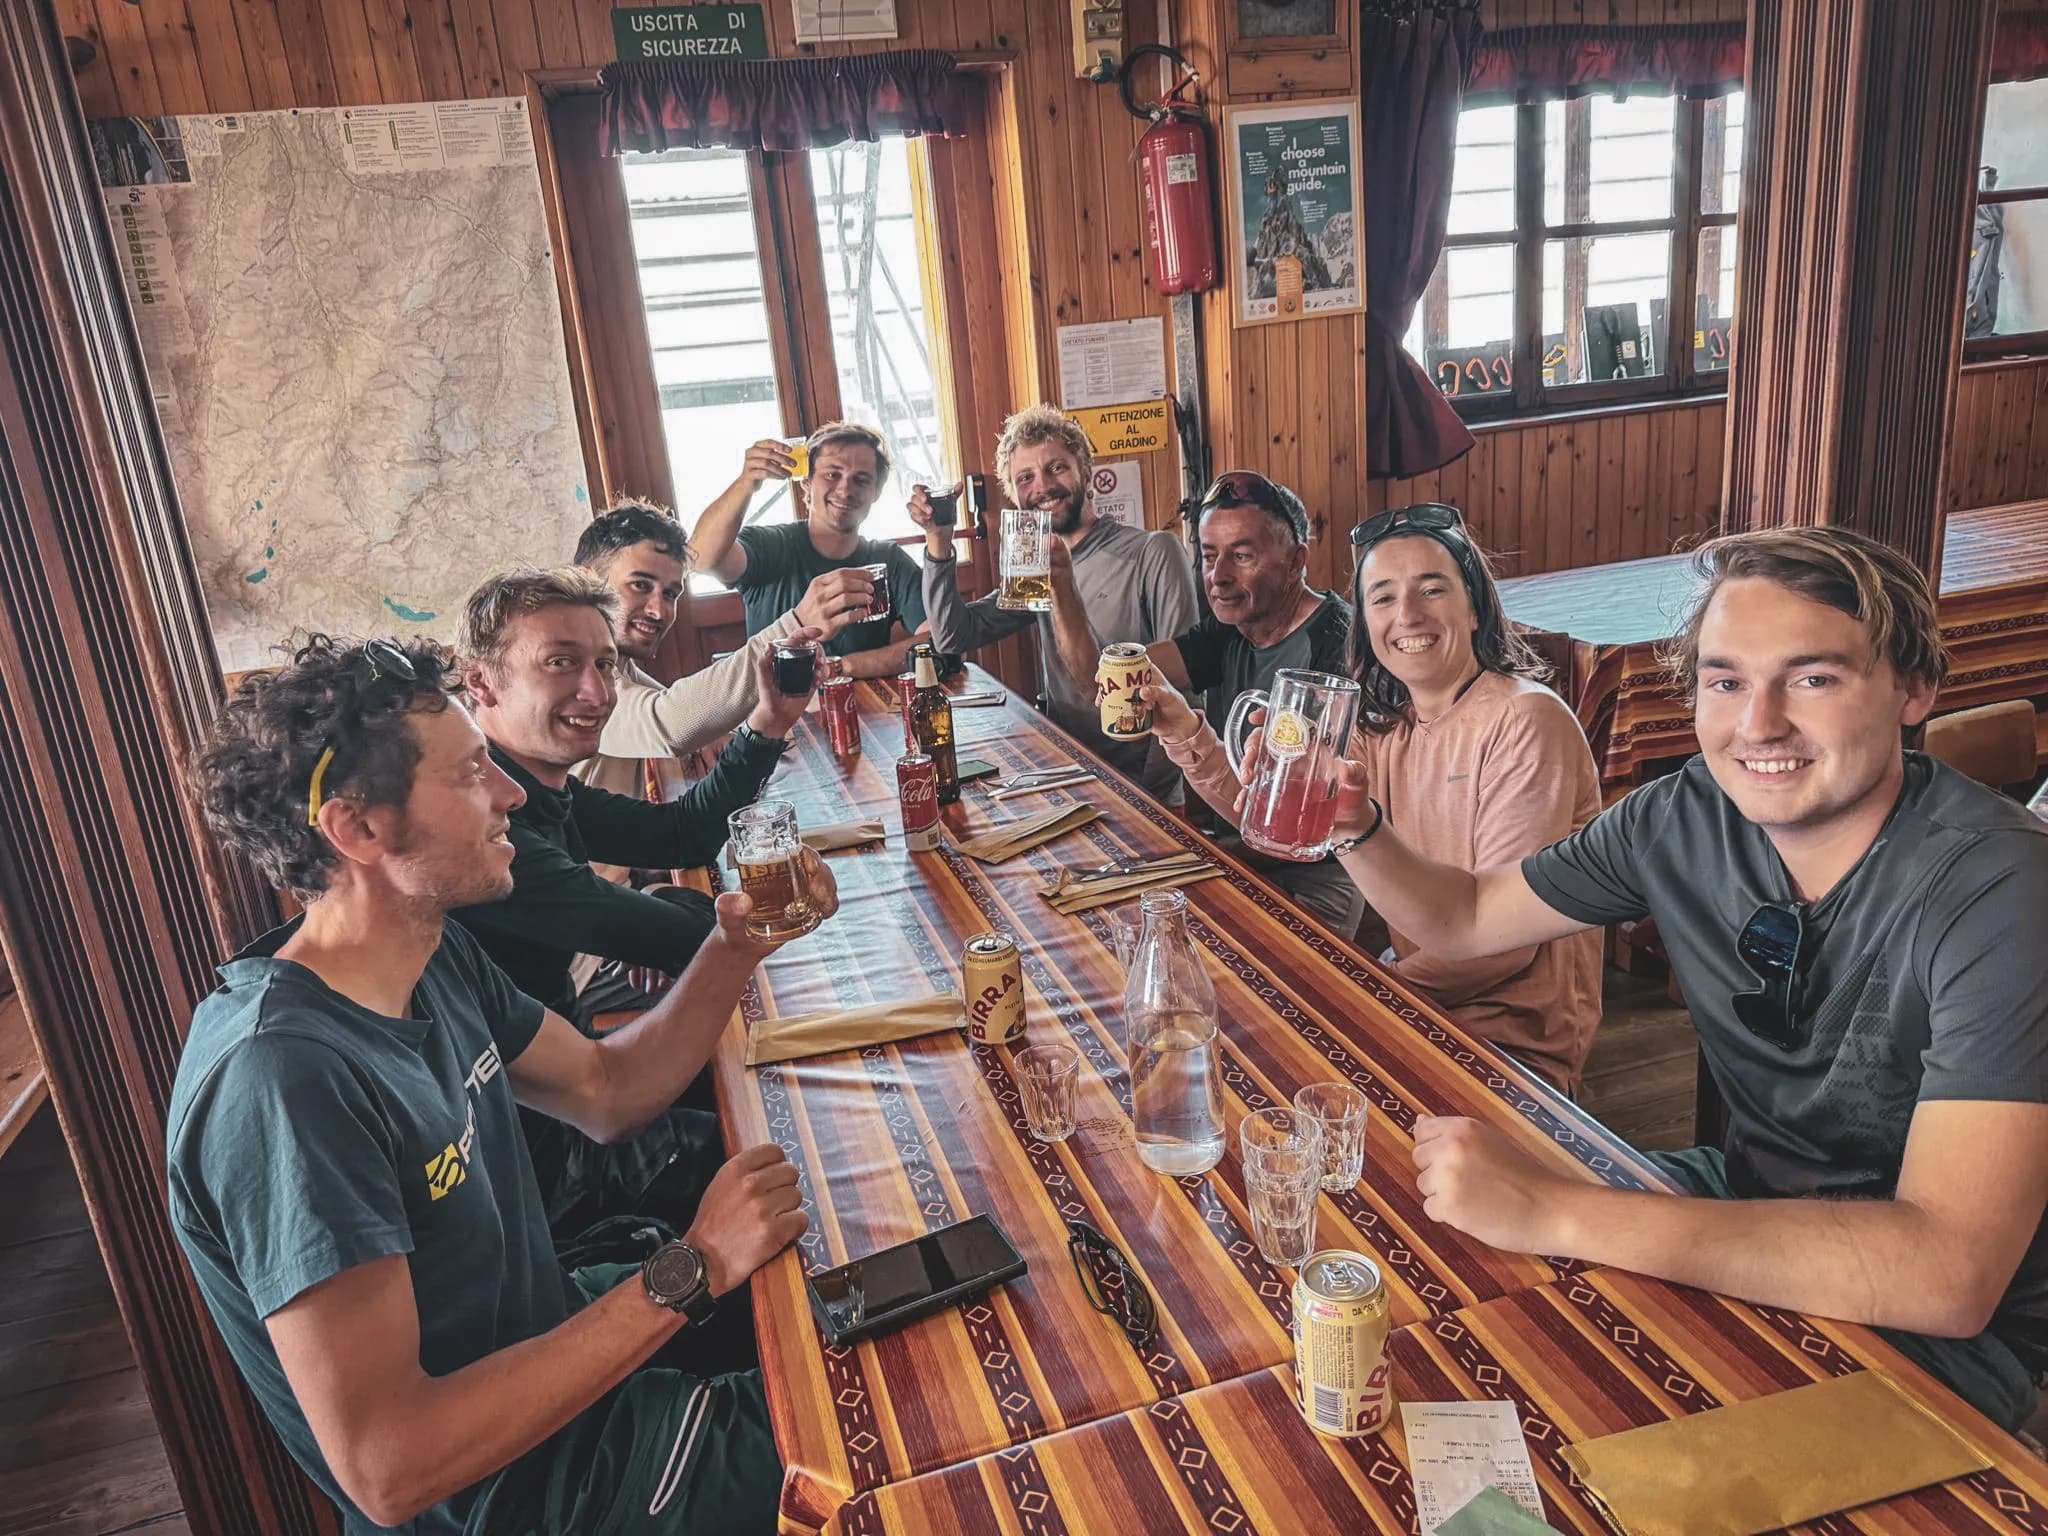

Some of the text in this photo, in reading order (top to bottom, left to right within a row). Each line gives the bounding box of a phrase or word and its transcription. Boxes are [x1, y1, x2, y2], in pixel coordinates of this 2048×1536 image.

[631, 12, 746, 32] USCITA DI
[642, 38, 742, 57] SICUREZZA
[1281, 146, 1325, 160] choose
[1288, 161, 1346, 179] mountain
[1298, 159, 1306, 168] a
[1286, 177, 1325, 196] guide.
[1100, 407, 1164, 424] ATTENZIONE
[1126, 424, 1139, 435] AL
[1110, 436, 1157, 450] GRADINO
[1097, 504, 1125, 514] ETATO
[1126, 669, 1152, 688] MO
[971, 973, 1016, 1040] BIRRA
